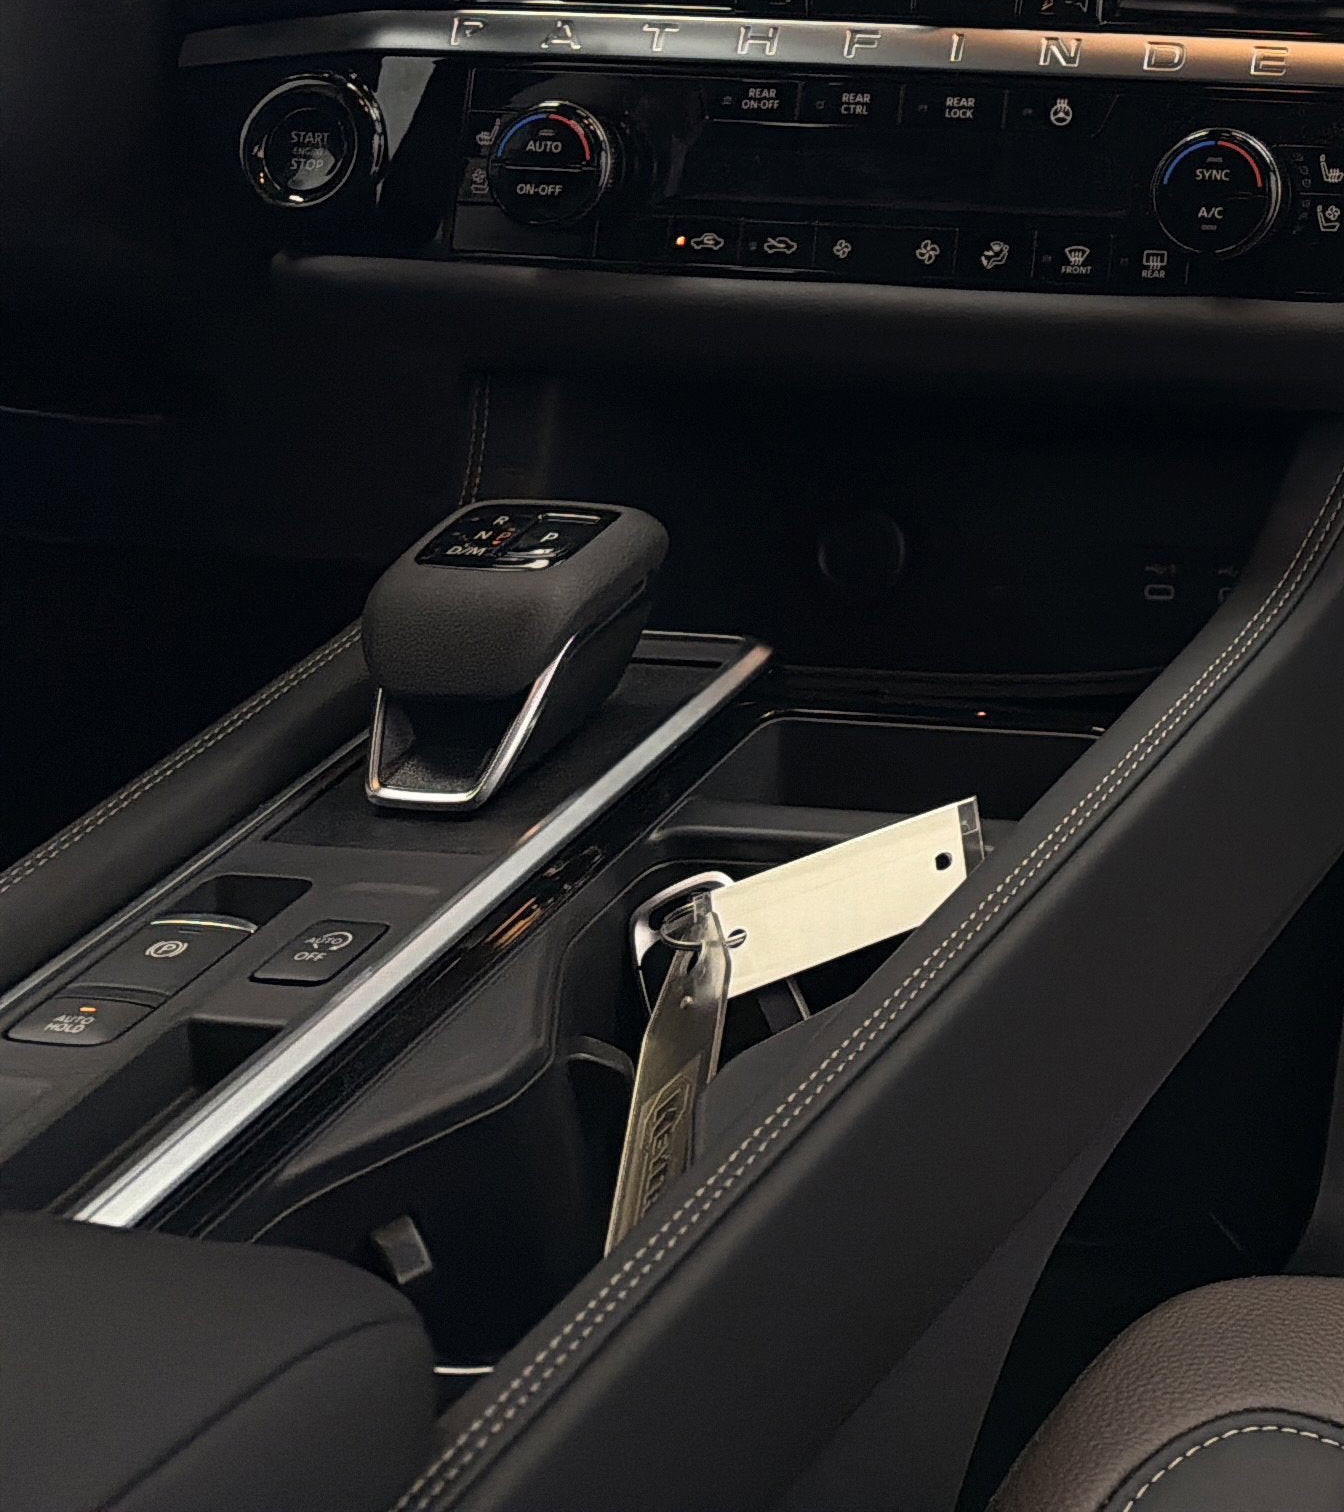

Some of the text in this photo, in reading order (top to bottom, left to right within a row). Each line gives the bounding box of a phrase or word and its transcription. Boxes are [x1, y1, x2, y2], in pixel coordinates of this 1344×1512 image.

[748, 88, 776, 99] REAR
[841, 92, 871, 104] REAR
[741, 98, 780, 110] ON-OFF
[945, 96, 975, 108] REAR
[840, 104, 870, 116] CTRL
[945, 107, 974, 119] LOCK
[290, 130, 329, 144] START
[525, 139, 563, 154] AUTO
[290, 158, 324, 170] STOP
[1195, 168, 1231, 182] SYNC
[516, 182, 563, 196] ON-OFF
[1198, 206, 1224, 219] A/C
[1061, 265, 1092, 275] FRONT
[1141, 269, 1165, 279] REAR
[493, 515, 510, 526] R
[474, 531, 493, 540] N
[538, 532, 559, 543] P
[445, 545, 488, 557] D/M
[304, 935, 344, 946] AUTO
[293, 951, 327, 962] OFF
[53, 1013, 96, 1025] AUTO
[44, 1022, 87, 1034] HOLD
